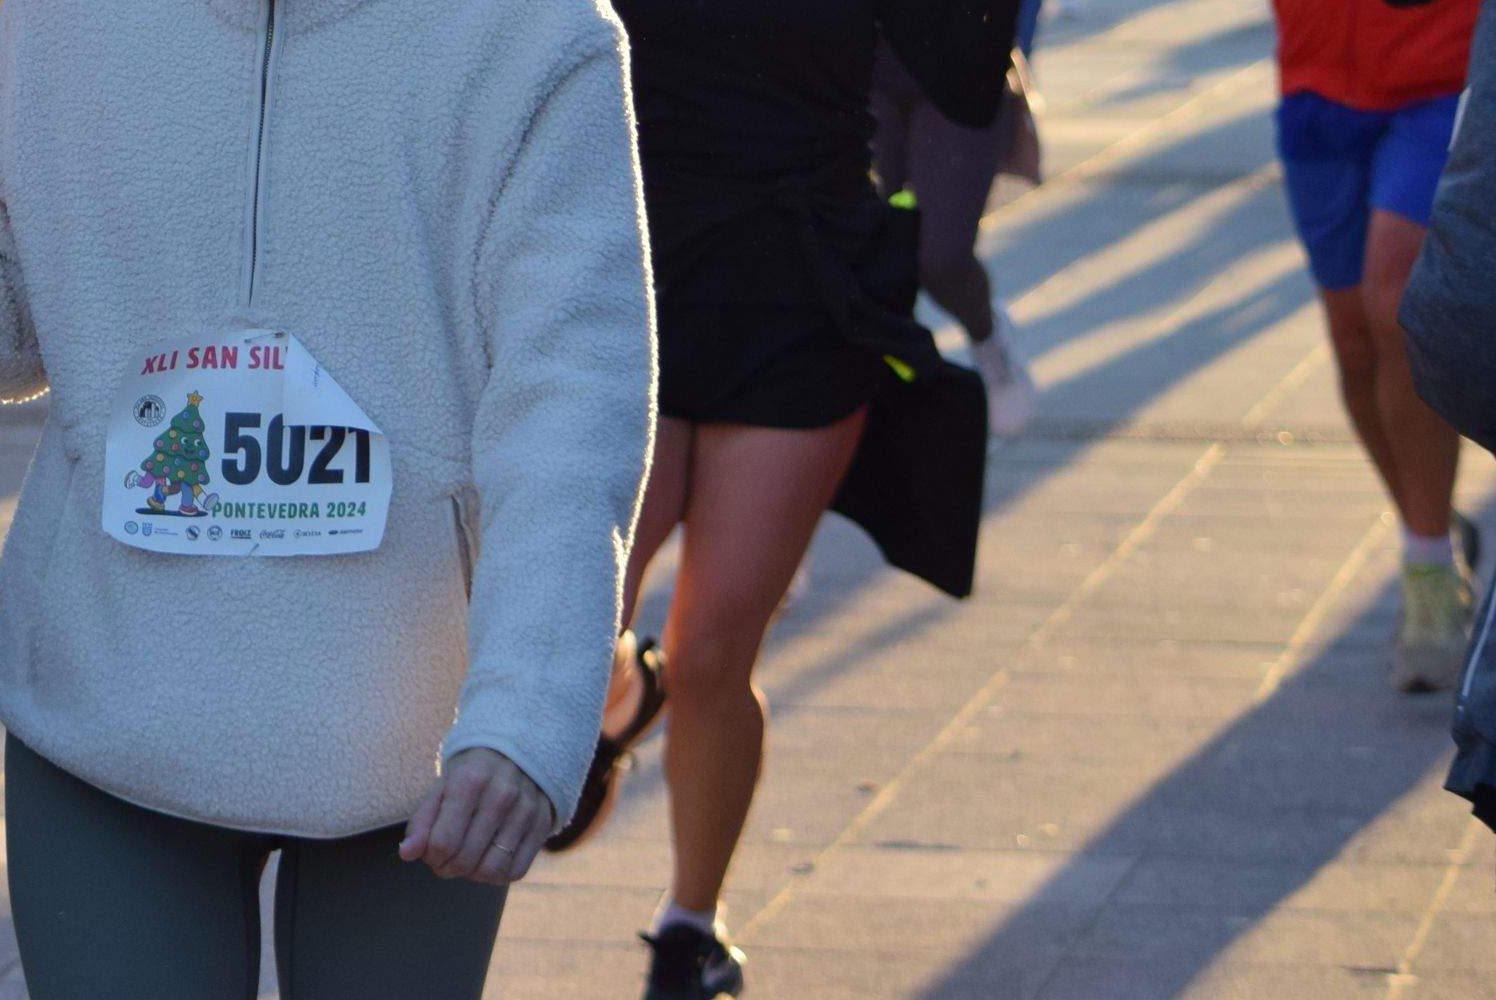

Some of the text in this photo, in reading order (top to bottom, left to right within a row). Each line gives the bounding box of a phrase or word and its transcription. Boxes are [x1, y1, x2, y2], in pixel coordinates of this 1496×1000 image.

[141, 345, 289, 376] XLI SAN SIL
[221, 412, 371, 486] 5021
[211, 501, 367, 519] PONTEVEDRA 2024
